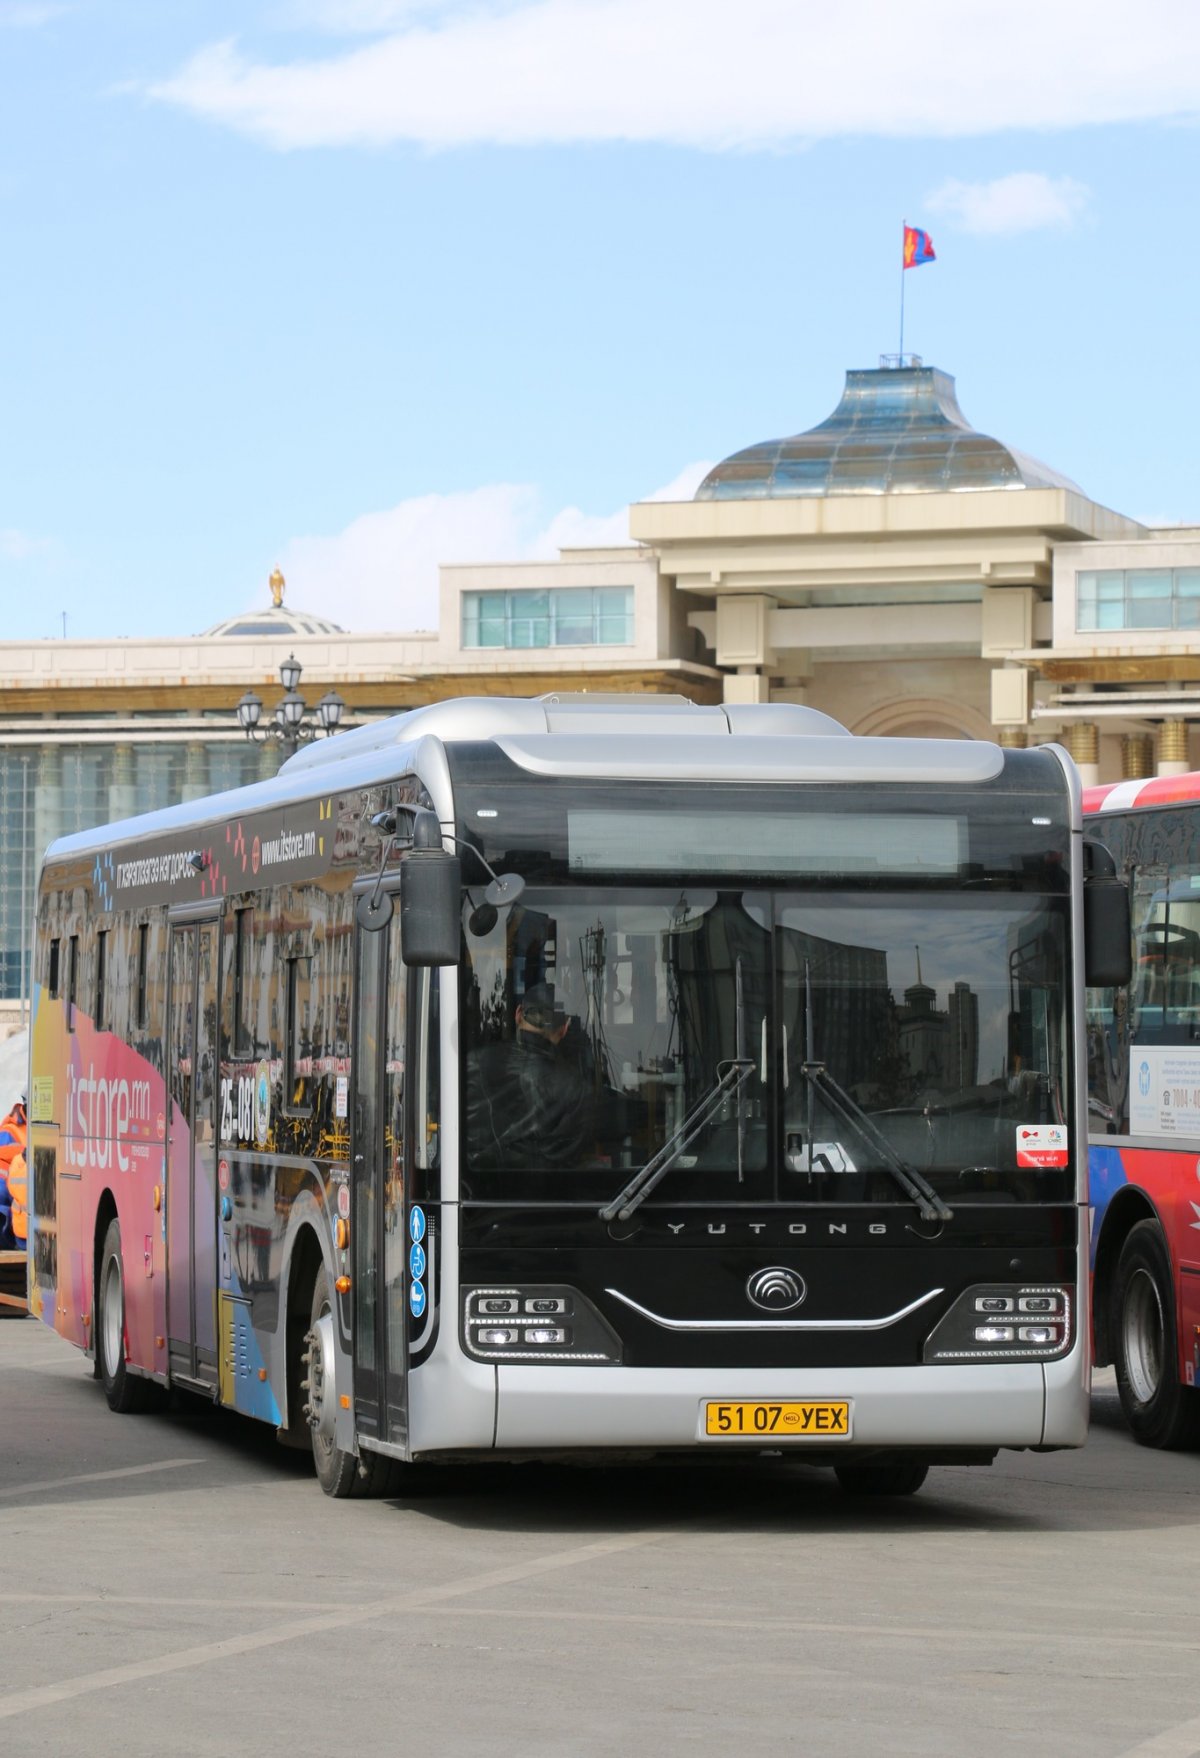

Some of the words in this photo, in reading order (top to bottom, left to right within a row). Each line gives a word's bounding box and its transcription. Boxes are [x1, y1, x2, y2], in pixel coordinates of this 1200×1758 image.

[262, 829, 316, 866] www.itstore.mn
[220, 1076, 256, 1141] 25-081
[667, 1223, 888, 1235] YUTONG
